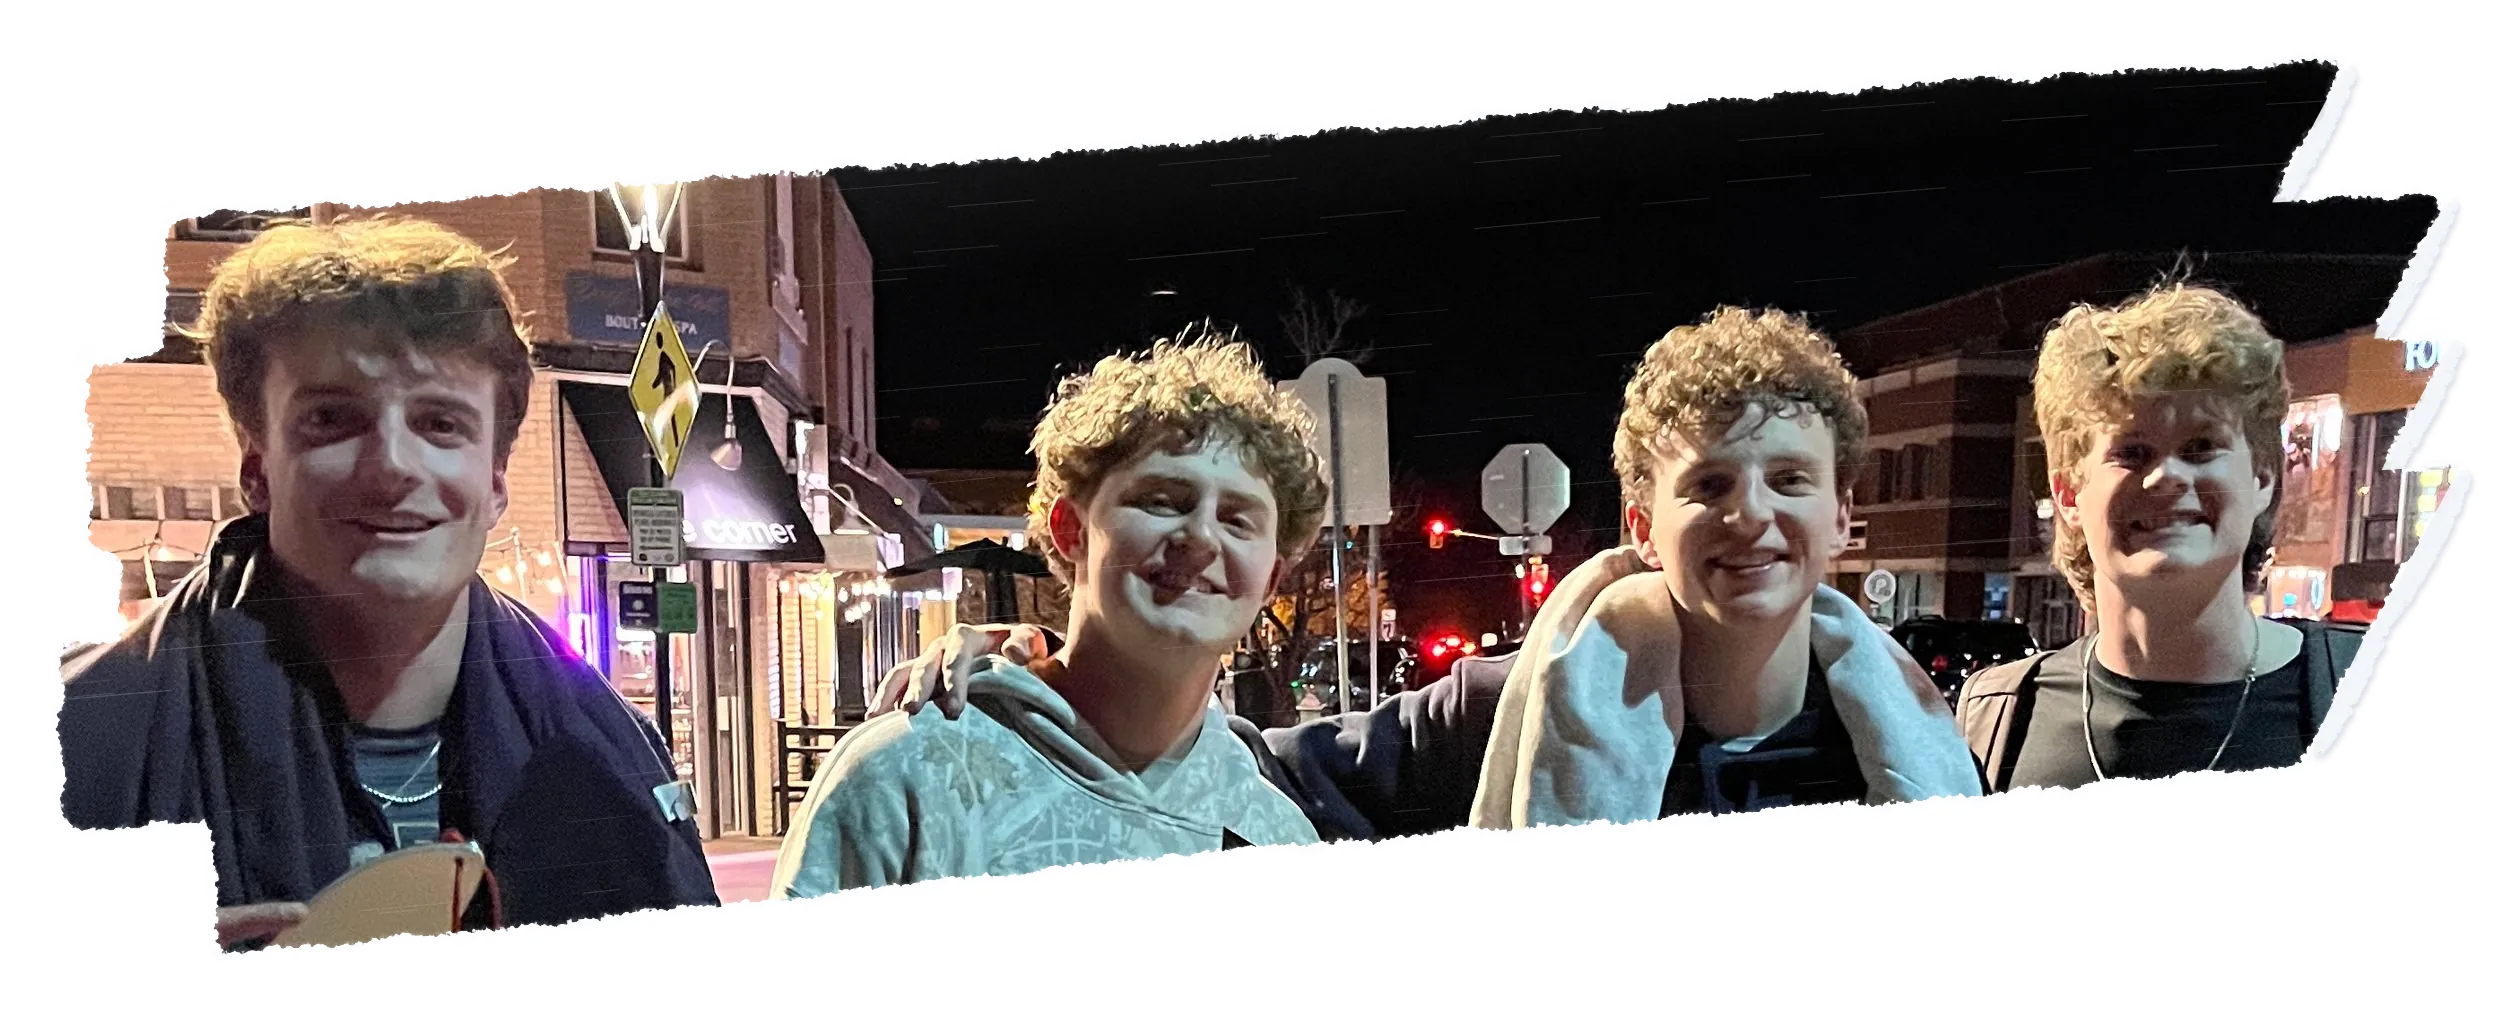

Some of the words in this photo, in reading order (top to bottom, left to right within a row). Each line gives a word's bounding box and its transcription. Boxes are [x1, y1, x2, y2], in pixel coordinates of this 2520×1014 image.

[605, 314, 638, 329] BOUT
[673, 321, 697, 335] SPA
[2404, 340, 2439, 371] FO
[682, 520, 697, 542] e
[702, 519, 797, 543] corner
